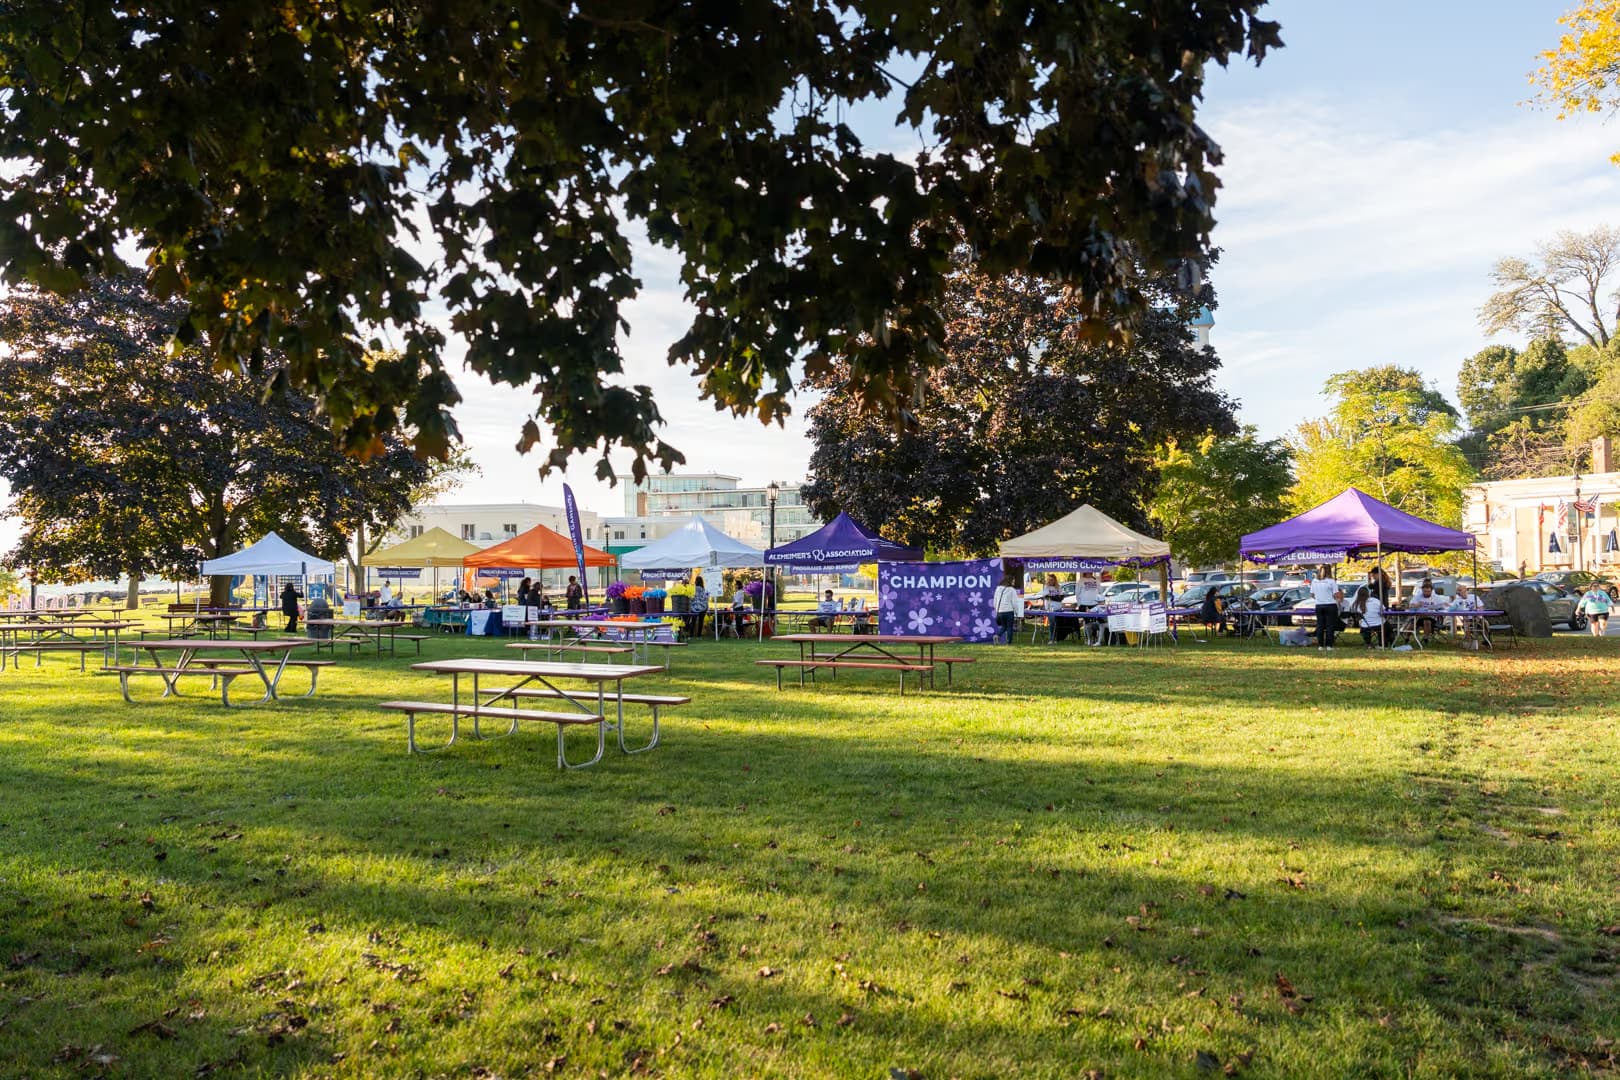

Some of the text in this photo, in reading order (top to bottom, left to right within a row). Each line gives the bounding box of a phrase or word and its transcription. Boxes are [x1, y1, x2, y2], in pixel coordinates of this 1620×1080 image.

[825, 549, 873, 558] ASSOCIATION
[1269, 551, 1345, 561] PUPLE CLUBHOUSE
[1027, 561, 1078, 569] CHAMPIONS
[890, 575, 992, 589] CHAMPION
